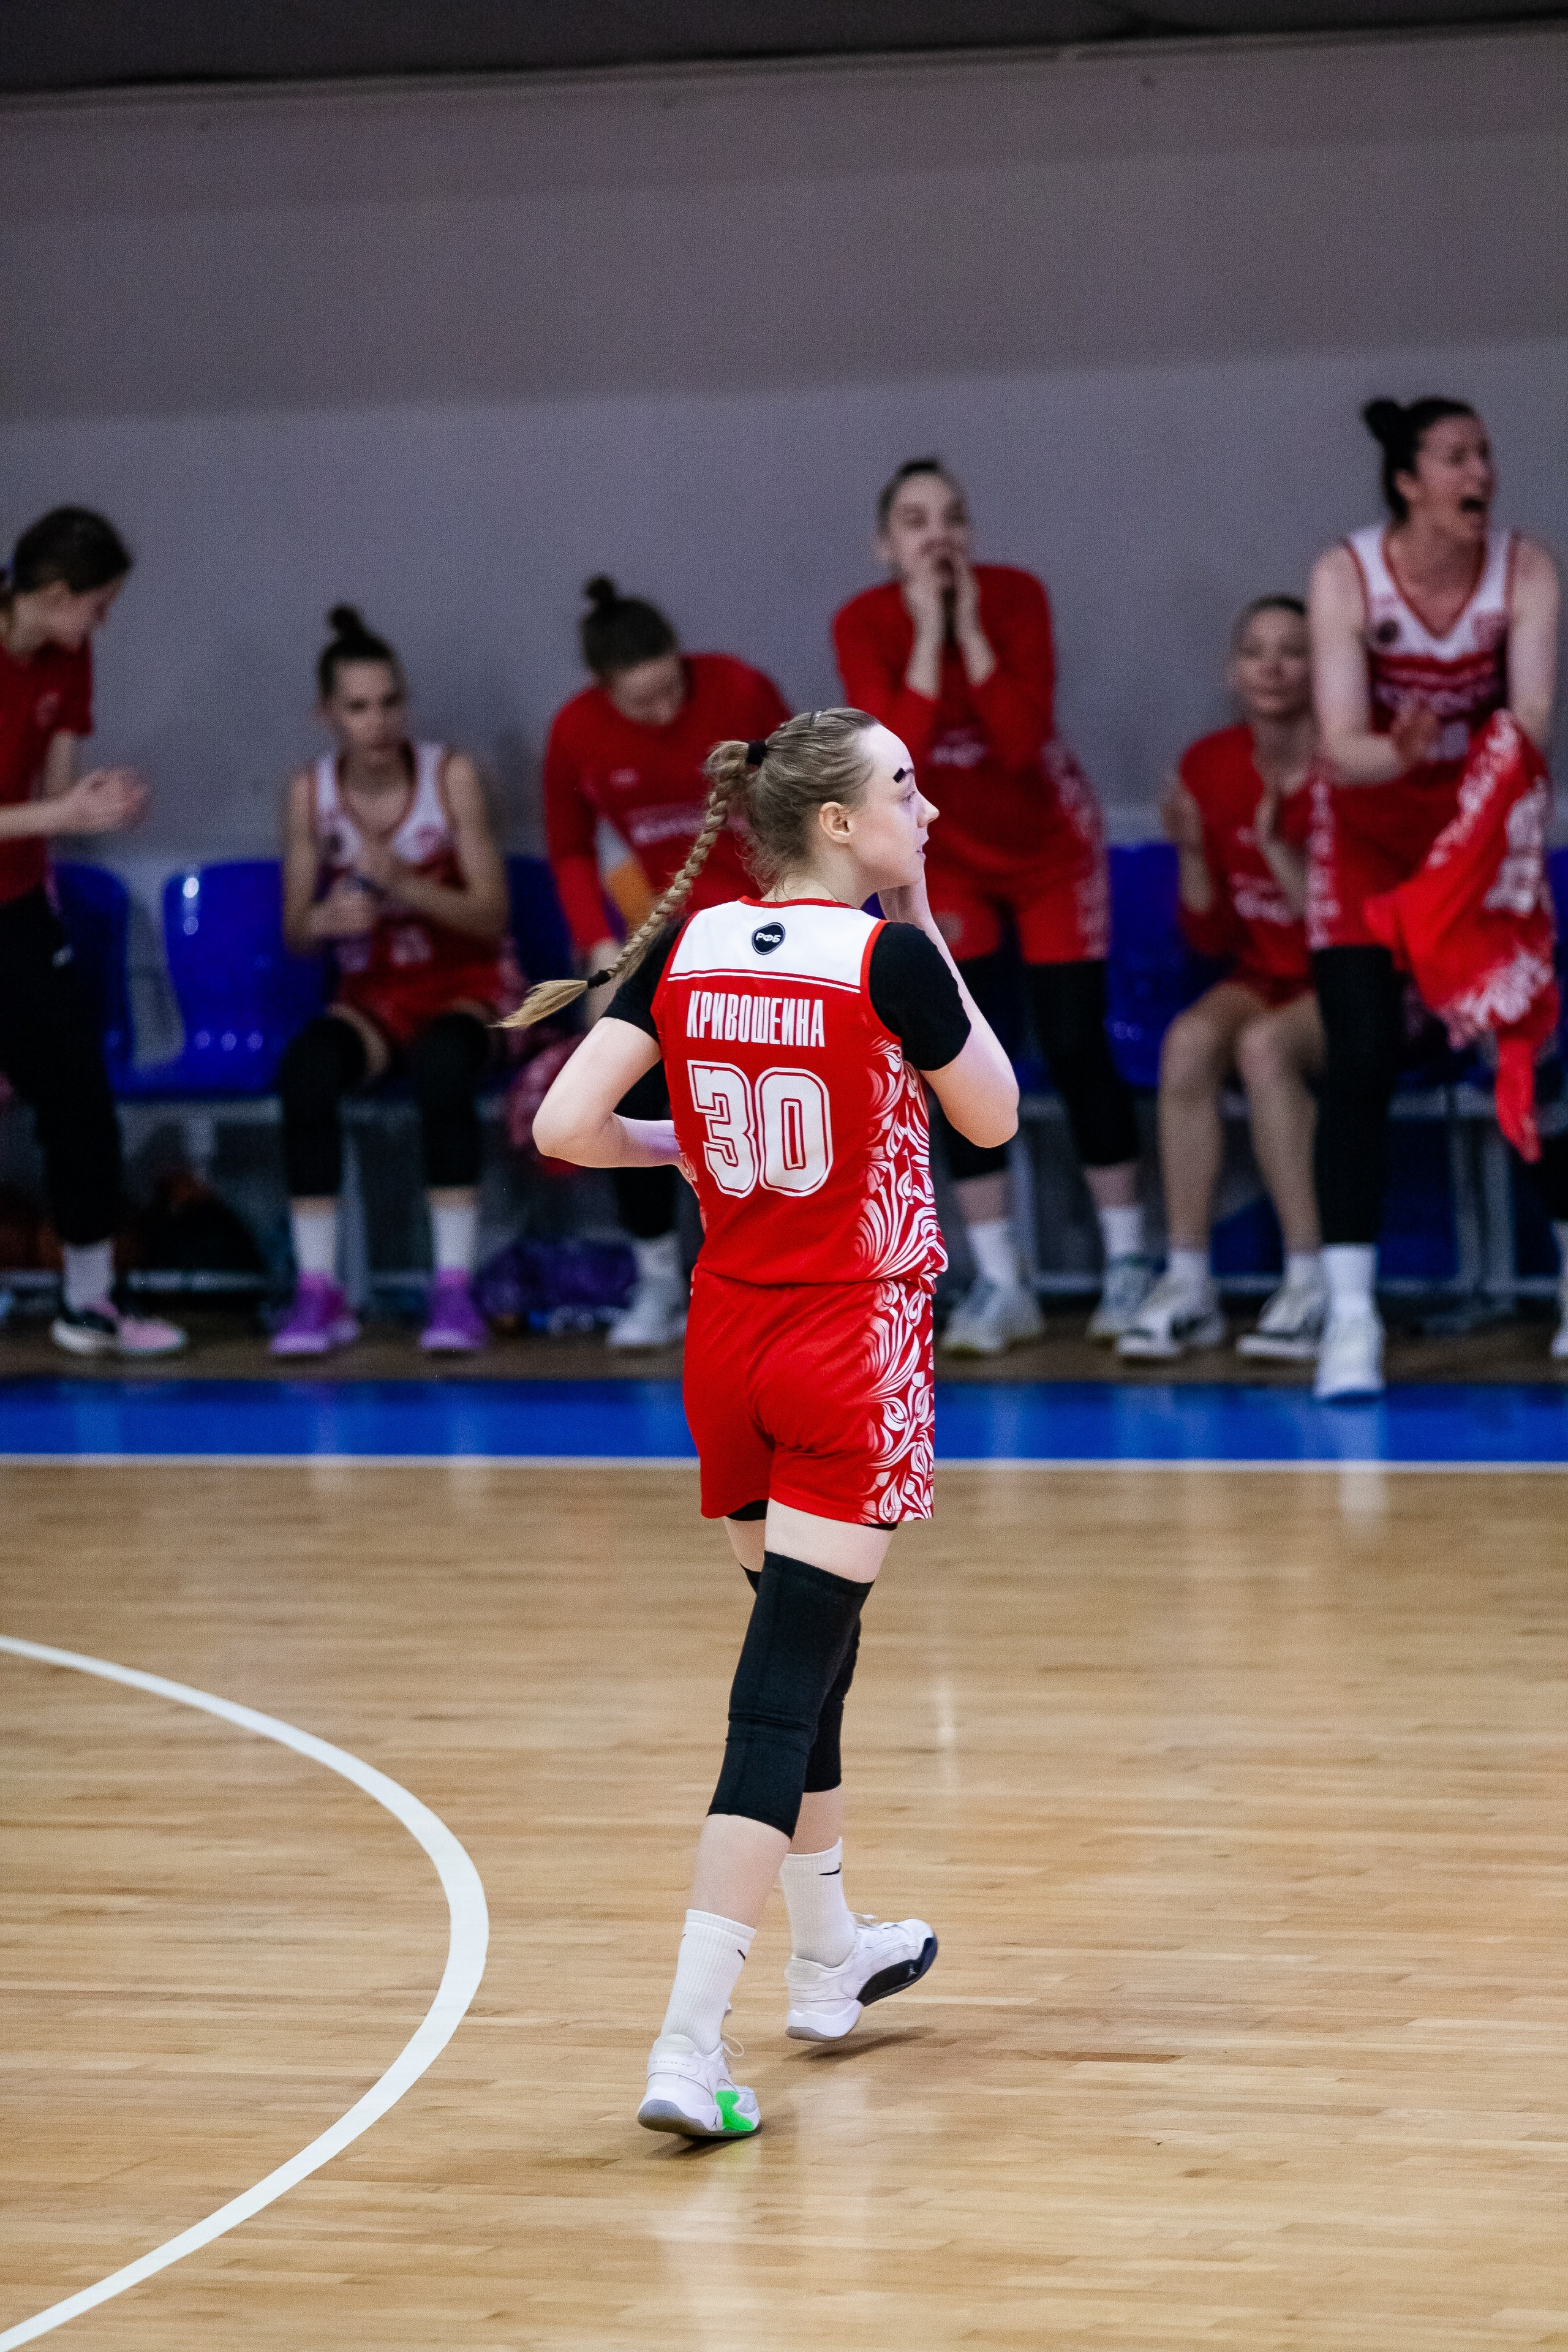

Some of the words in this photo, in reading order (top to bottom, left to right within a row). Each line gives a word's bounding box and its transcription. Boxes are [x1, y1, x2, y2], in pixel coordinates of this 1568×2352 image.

[755, 932, 782, 943] РФБ
[686, 990, 826, 1047] КРИВОШЕИНА
[687, 1059, 834, 1199] 30
